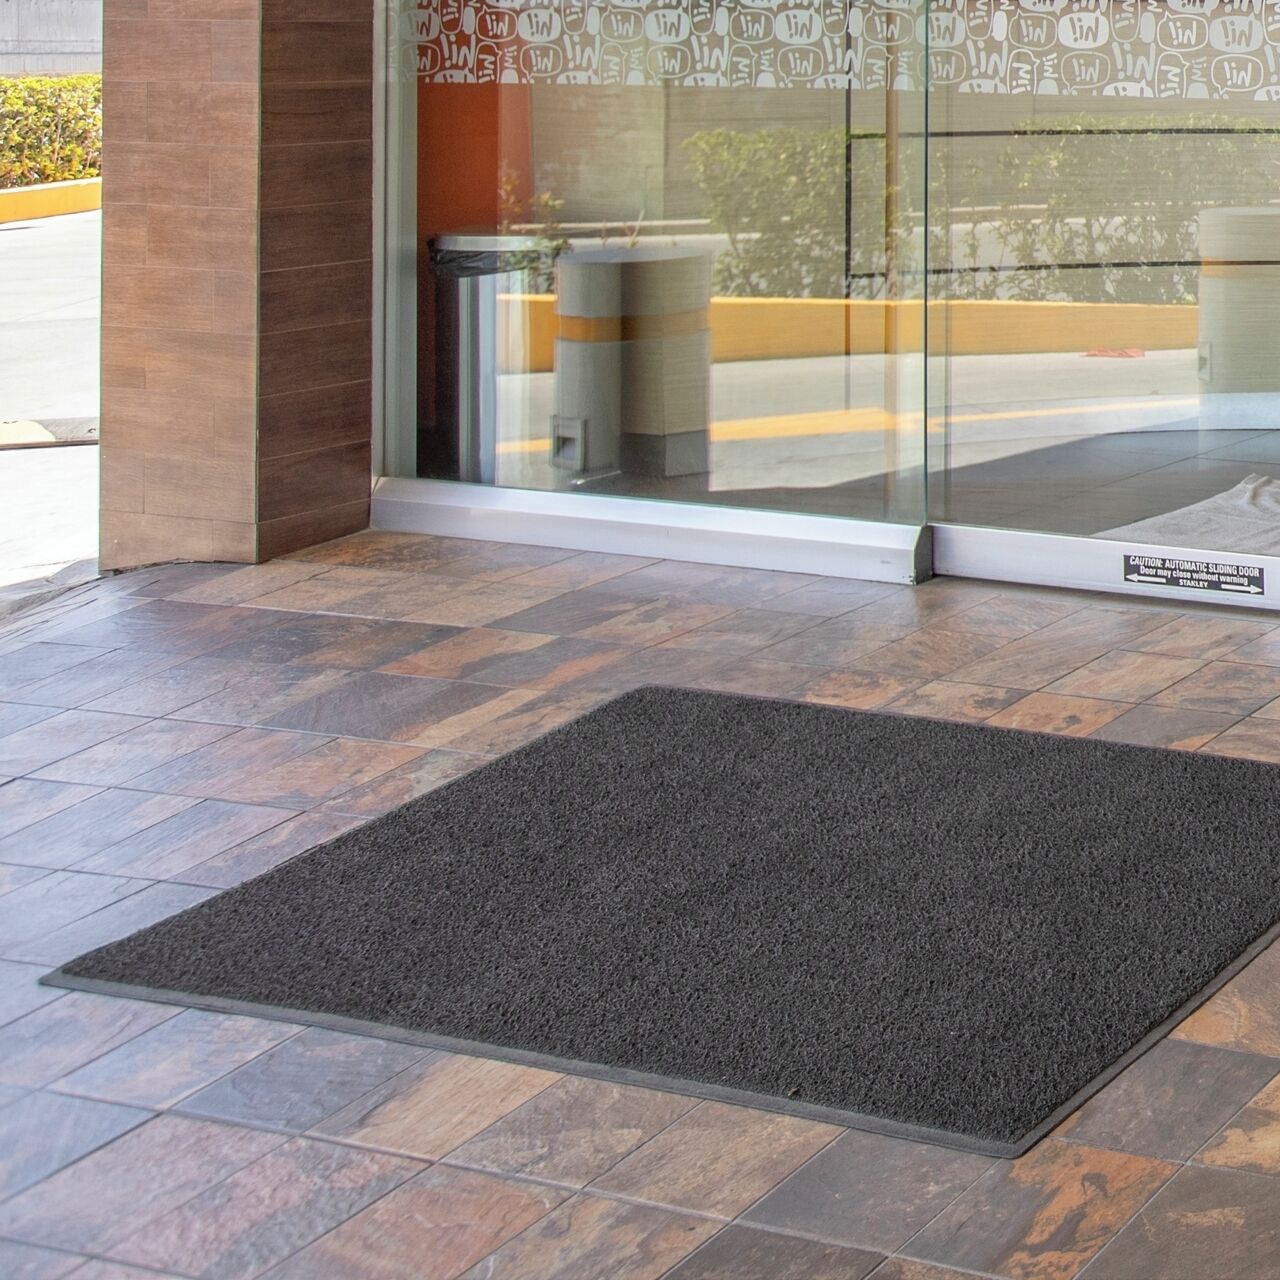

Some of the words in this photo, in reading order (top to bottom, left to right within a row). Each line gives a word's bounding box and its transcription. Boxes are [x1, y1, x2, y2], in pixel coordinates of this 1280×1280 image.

[1129, 556, 1163, 568] CAUTION:
[1165, 559, 1207, 572] AUTOMATIC
[1208, 563, 1238, 575] SLIDING
[1239, 566, 1260, 577] DOOR
[1140, 566, 1156, 576] Door
[1157, 568, 1171, 578] may
[1173, 570, 1191, 579] close
[1192, 571, 1218, 582] without
[1220, 575, 1248, 586] warning
